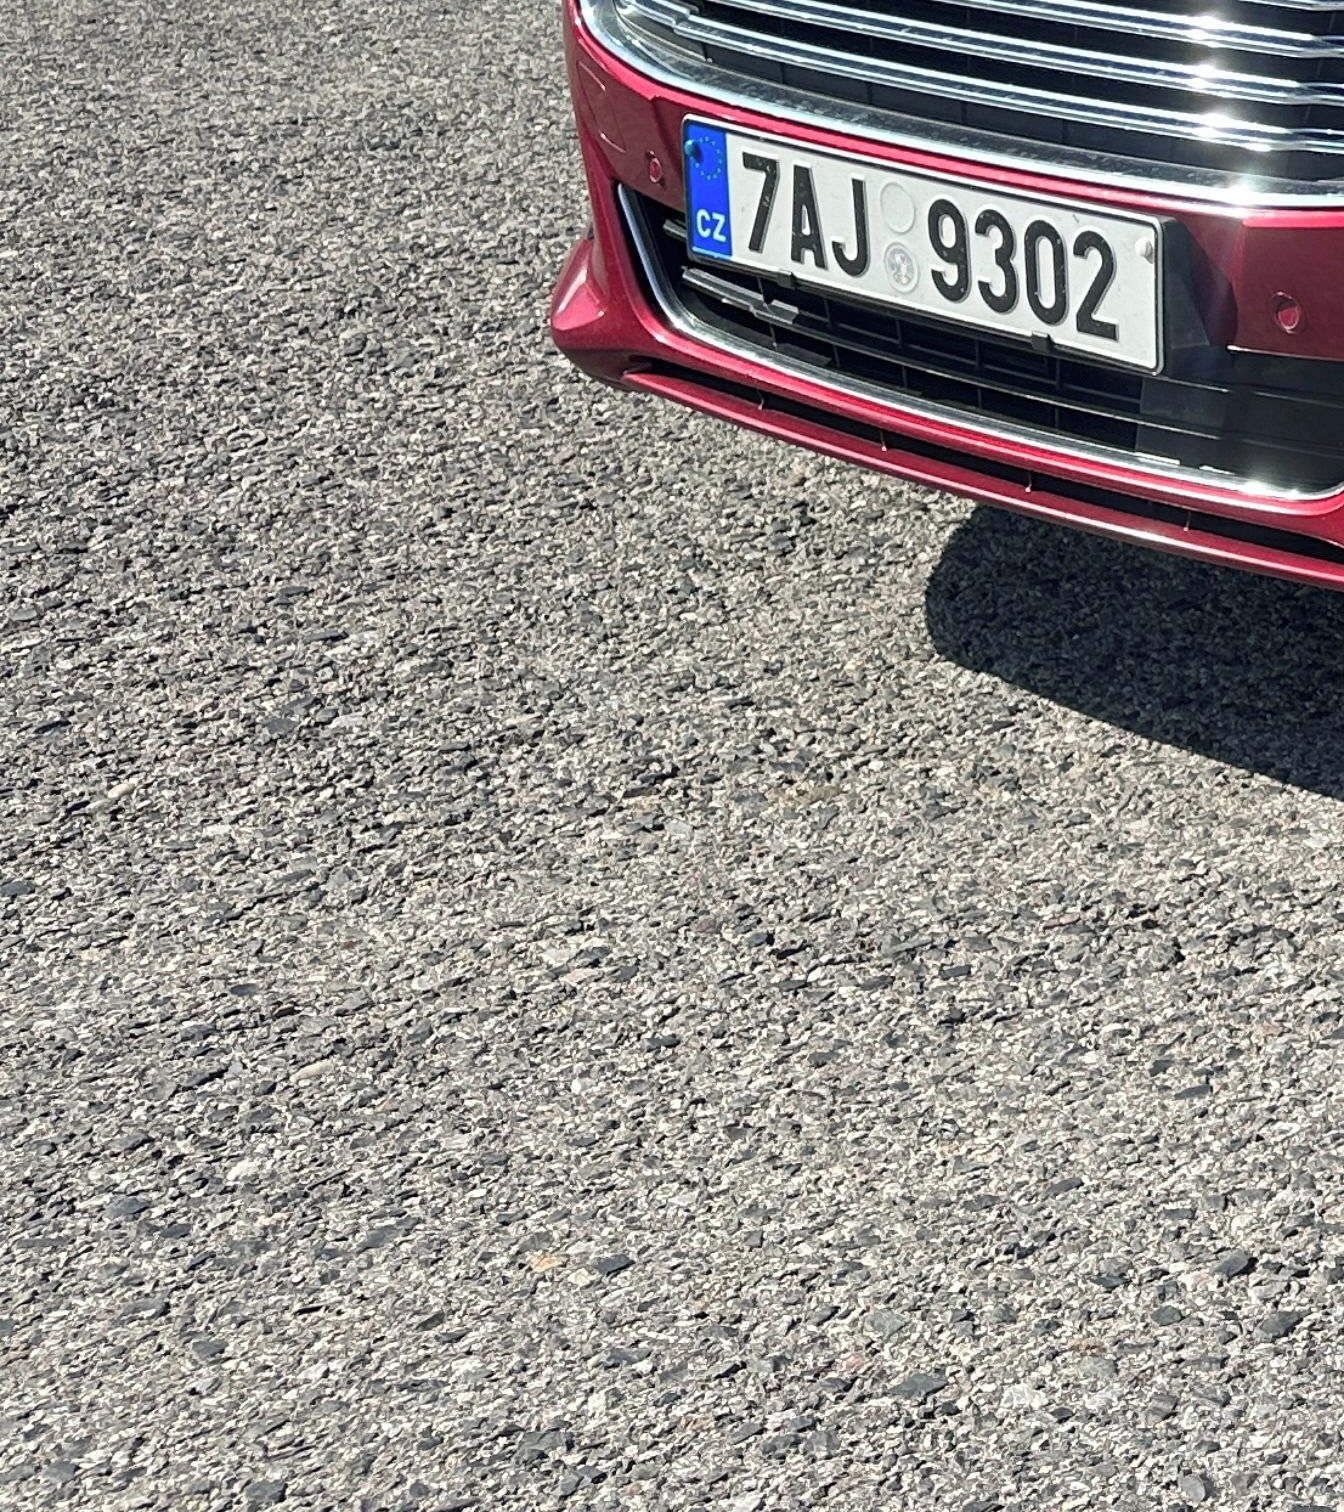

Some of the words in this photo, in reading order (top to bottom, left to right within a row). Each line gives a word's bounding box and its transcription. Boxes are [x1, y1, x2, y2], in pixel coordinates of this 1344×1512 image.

[695, 207, 729, 244] CZ
[741, 150, 873, 279] 7AJ
[926, 197, 1121, 342] 9302
